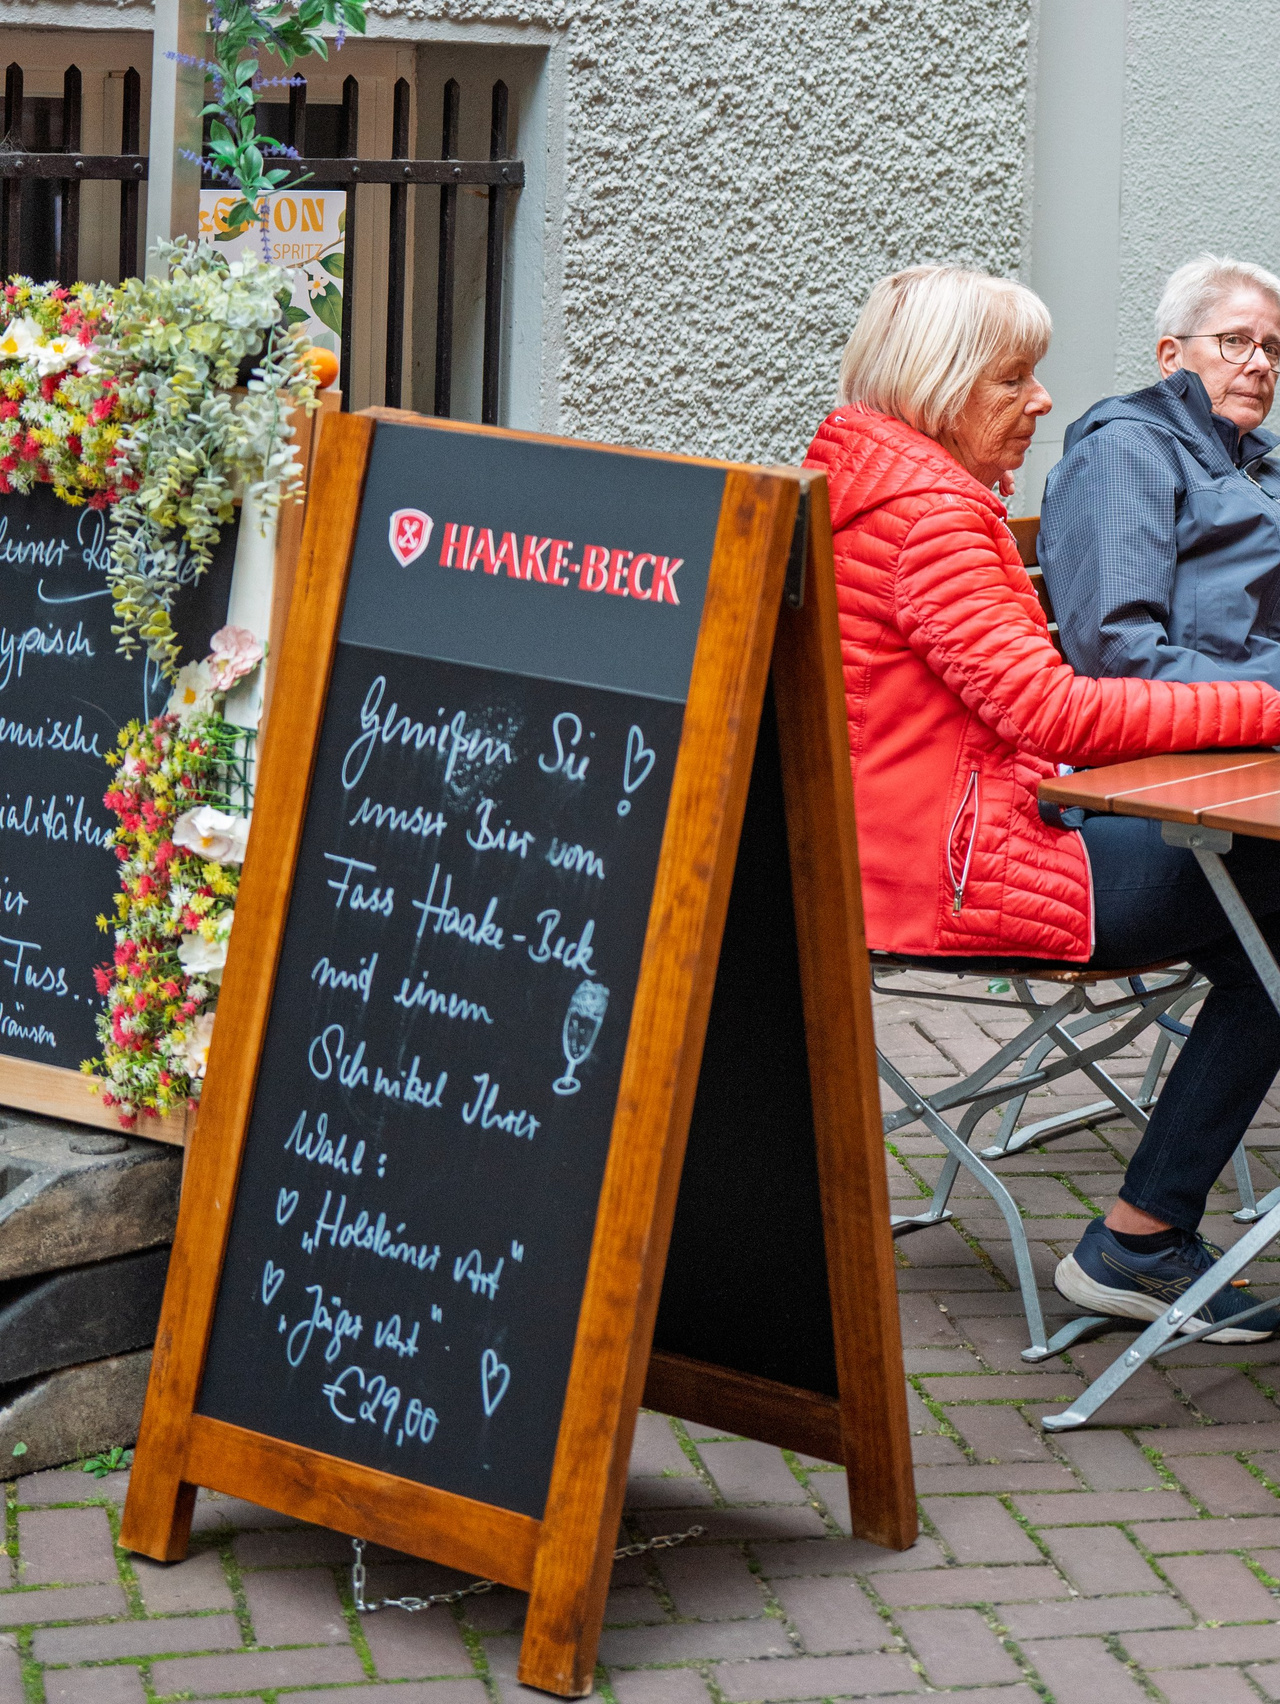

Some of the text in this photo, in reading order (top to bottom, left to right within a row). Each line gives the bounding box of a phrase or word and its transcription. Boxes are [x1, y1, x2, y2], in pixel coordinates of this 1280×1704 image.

[273, 243, 324, 260] SPRITZ
[439, 522, 684, 606] HAAKE-BECK
[466, 799, 536, 859] Bier
[547, 836, 605, 881] vom
[323, 852, 597, 977] Fass Haake-Beck
